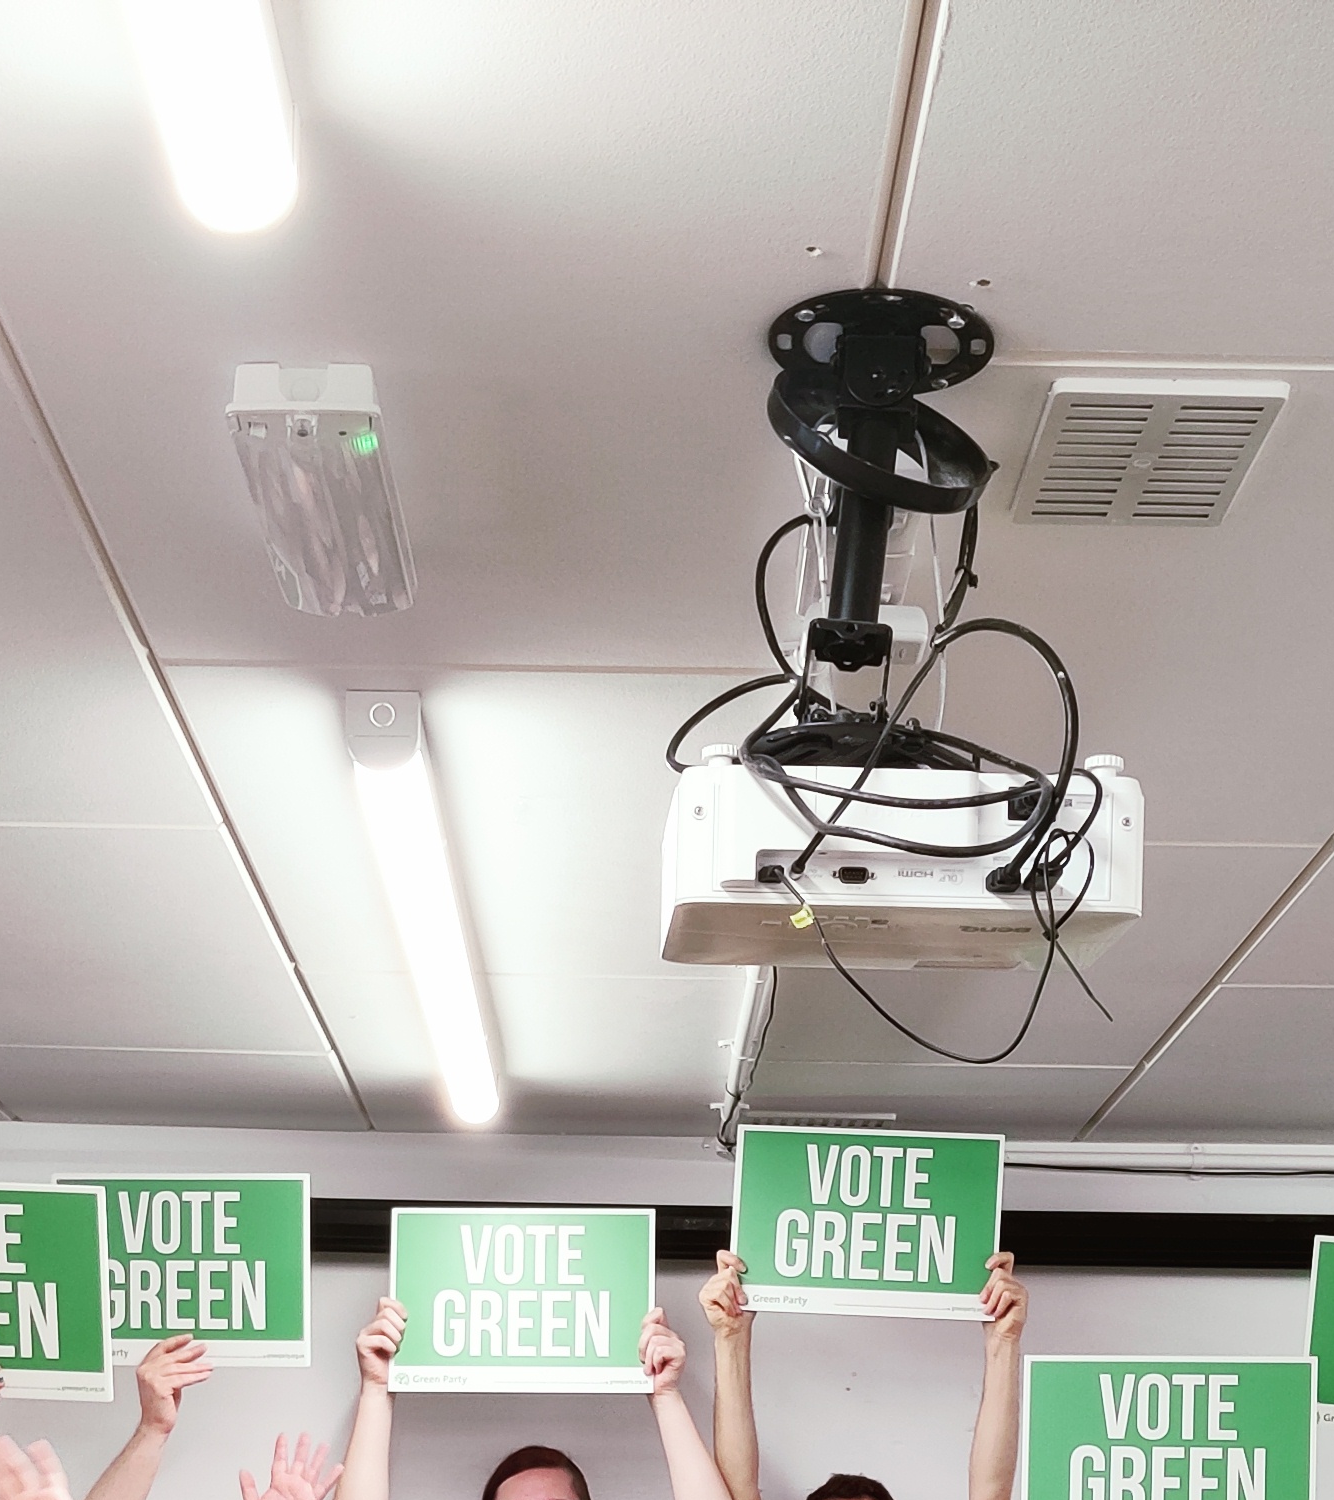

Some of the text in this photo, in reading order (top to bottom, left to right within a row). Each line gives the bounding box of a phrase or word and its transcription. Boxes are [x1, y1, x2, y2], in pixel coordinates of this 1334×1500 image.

[807, 1144, 934, 1208] VOTE
[117, 1190, 241, 1254] VOTE
[775, 1208, 956, 1283] GREEN
[460, 1224, 585, 1285] VOTE
[108, 1259, 267, 1331] GREEN
[432, 1289, 610, 1357] GREEN
[752, 1294, 808, 1307] Green Party
[112, 1349, 128, 1359] arty
[412, 1375, 468, 1385] Green Party
[1098, 1373, 1239, 1441] VOTE
